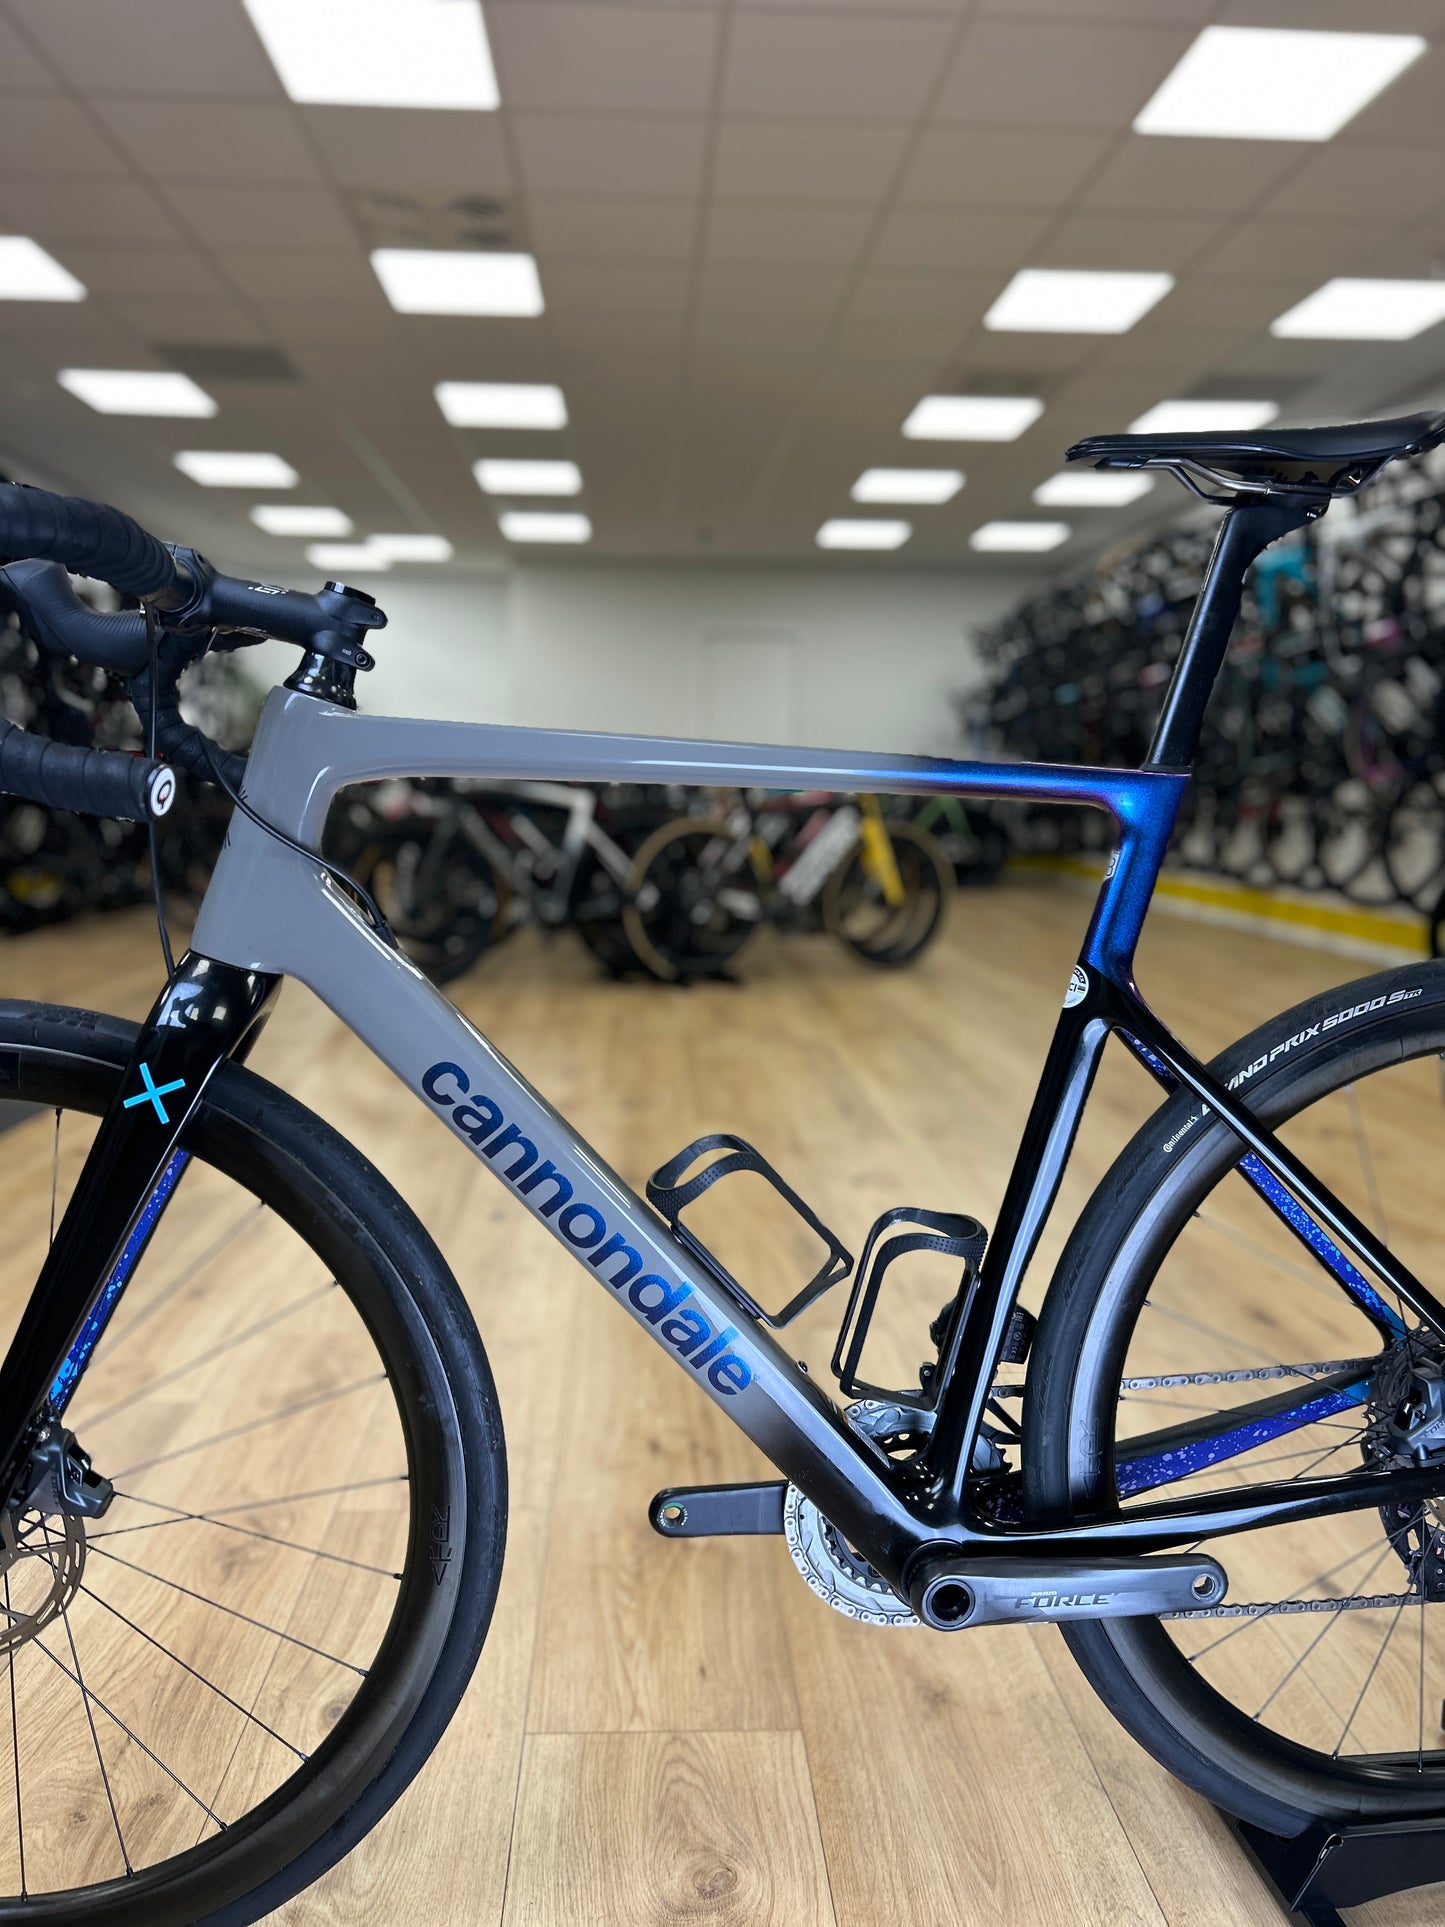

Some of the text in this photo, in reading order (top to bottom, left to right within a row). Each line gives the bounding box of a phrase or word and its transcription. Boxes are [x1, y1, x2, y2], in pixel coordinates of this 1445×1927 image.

[1269, 1022, 1321, 1062] PRIX
[1322, 995, 1387, 1032] 5000
[421, 1061, 753, 1396] cannondale
[1014, 1594, 1110, 1609] FORCE
